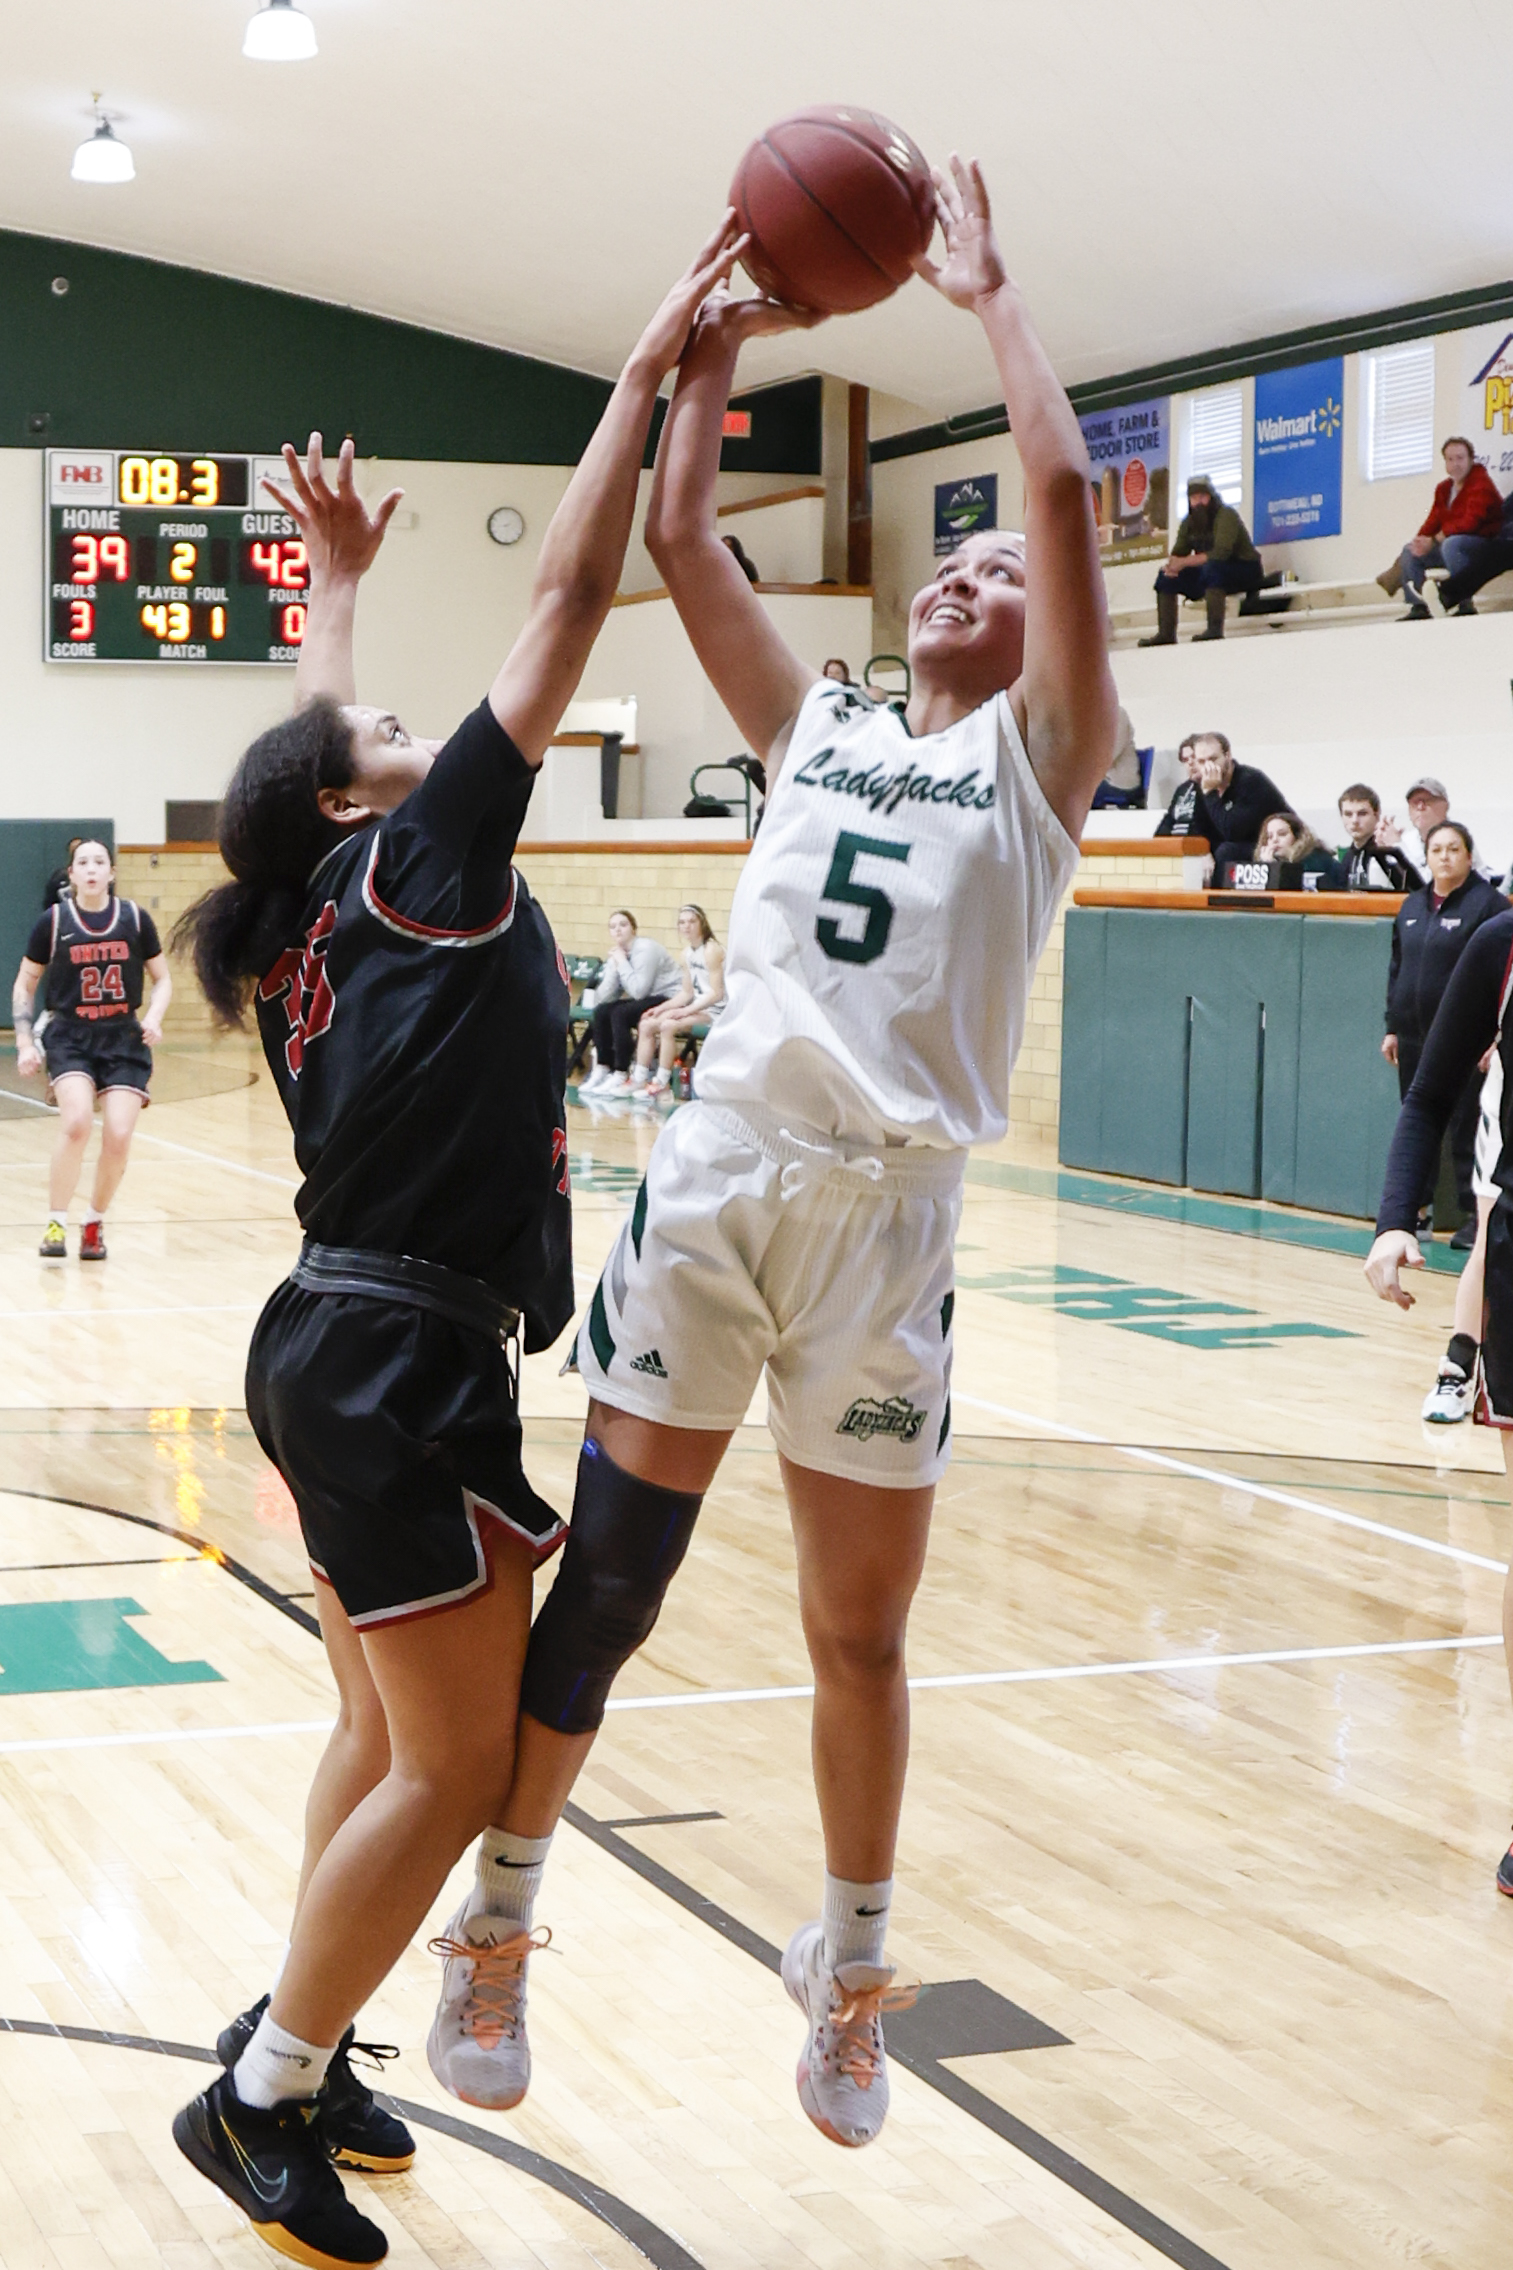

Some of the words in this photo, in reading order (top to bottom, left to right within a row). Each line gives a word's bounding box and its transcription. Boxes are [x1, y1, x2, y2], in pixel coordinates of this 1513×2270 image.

[1119, 412, 1148, 434] FARM
[1151, 410, 1159, 428] &
[1257, 409, 1317, 443] Walmart
[1125, 431, 1160, 454] STORE
[60, 464, 103, 483] FNB
[120, 457, 219, 507] 08.3
[62, 509, 120, 531] HOME
[159, 523, 208, 538] PERIOD
[72, 533, 130, 584] 39
[169, 541, 197, 583] 2
[250, 540, 308, 590] 42
[53, 583, 97, 600] FOULS
[137, 585, 188, 600] PLAYER
[195, 587, 229, 602] FOUL
[68, 599, 95, 641] 3
[141, 602, 192, 643] 43
[209, 604, 226, 640] 1
[282, 603, 307, 647] 0
[53, 642, 97, 658] SCORE
[159, 643, 207, 659] MATCH
[793, 747, 995, 815] Ladyjacks
[1235, 863, 1269, 884] POSS
[814, 828, 914, 966] 5
[70, 940, 130, 964] UNITED
[81, 963, 126, 1002] 24
